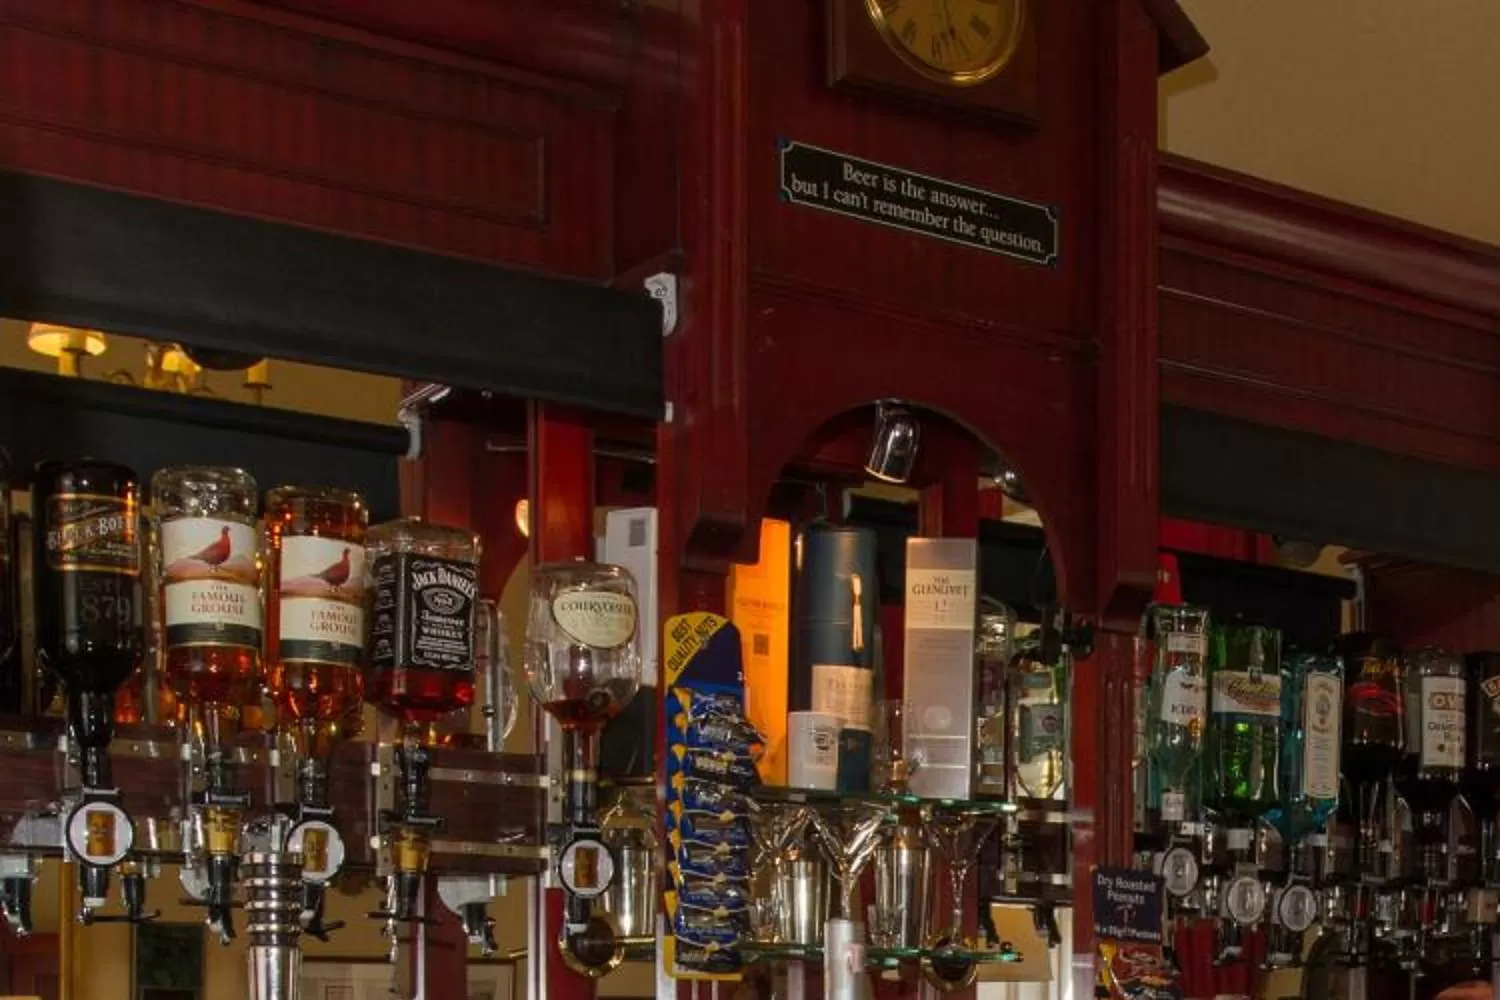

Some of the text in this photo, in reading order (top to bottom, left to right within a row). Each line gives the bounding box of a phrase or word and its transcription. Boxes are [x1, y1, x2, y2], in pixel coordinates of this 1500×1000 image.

[791, 173, 818, 198] but
[823, 183, 830, 200] I
[833, 188, 869, 209] can't
[872, 199, 950, 230] remember
[953, 215, 977, 237] the
[843, 162, 878, 189] Beer
[883, 172, 897, 193] is
[901, 178, 926, 201] the
